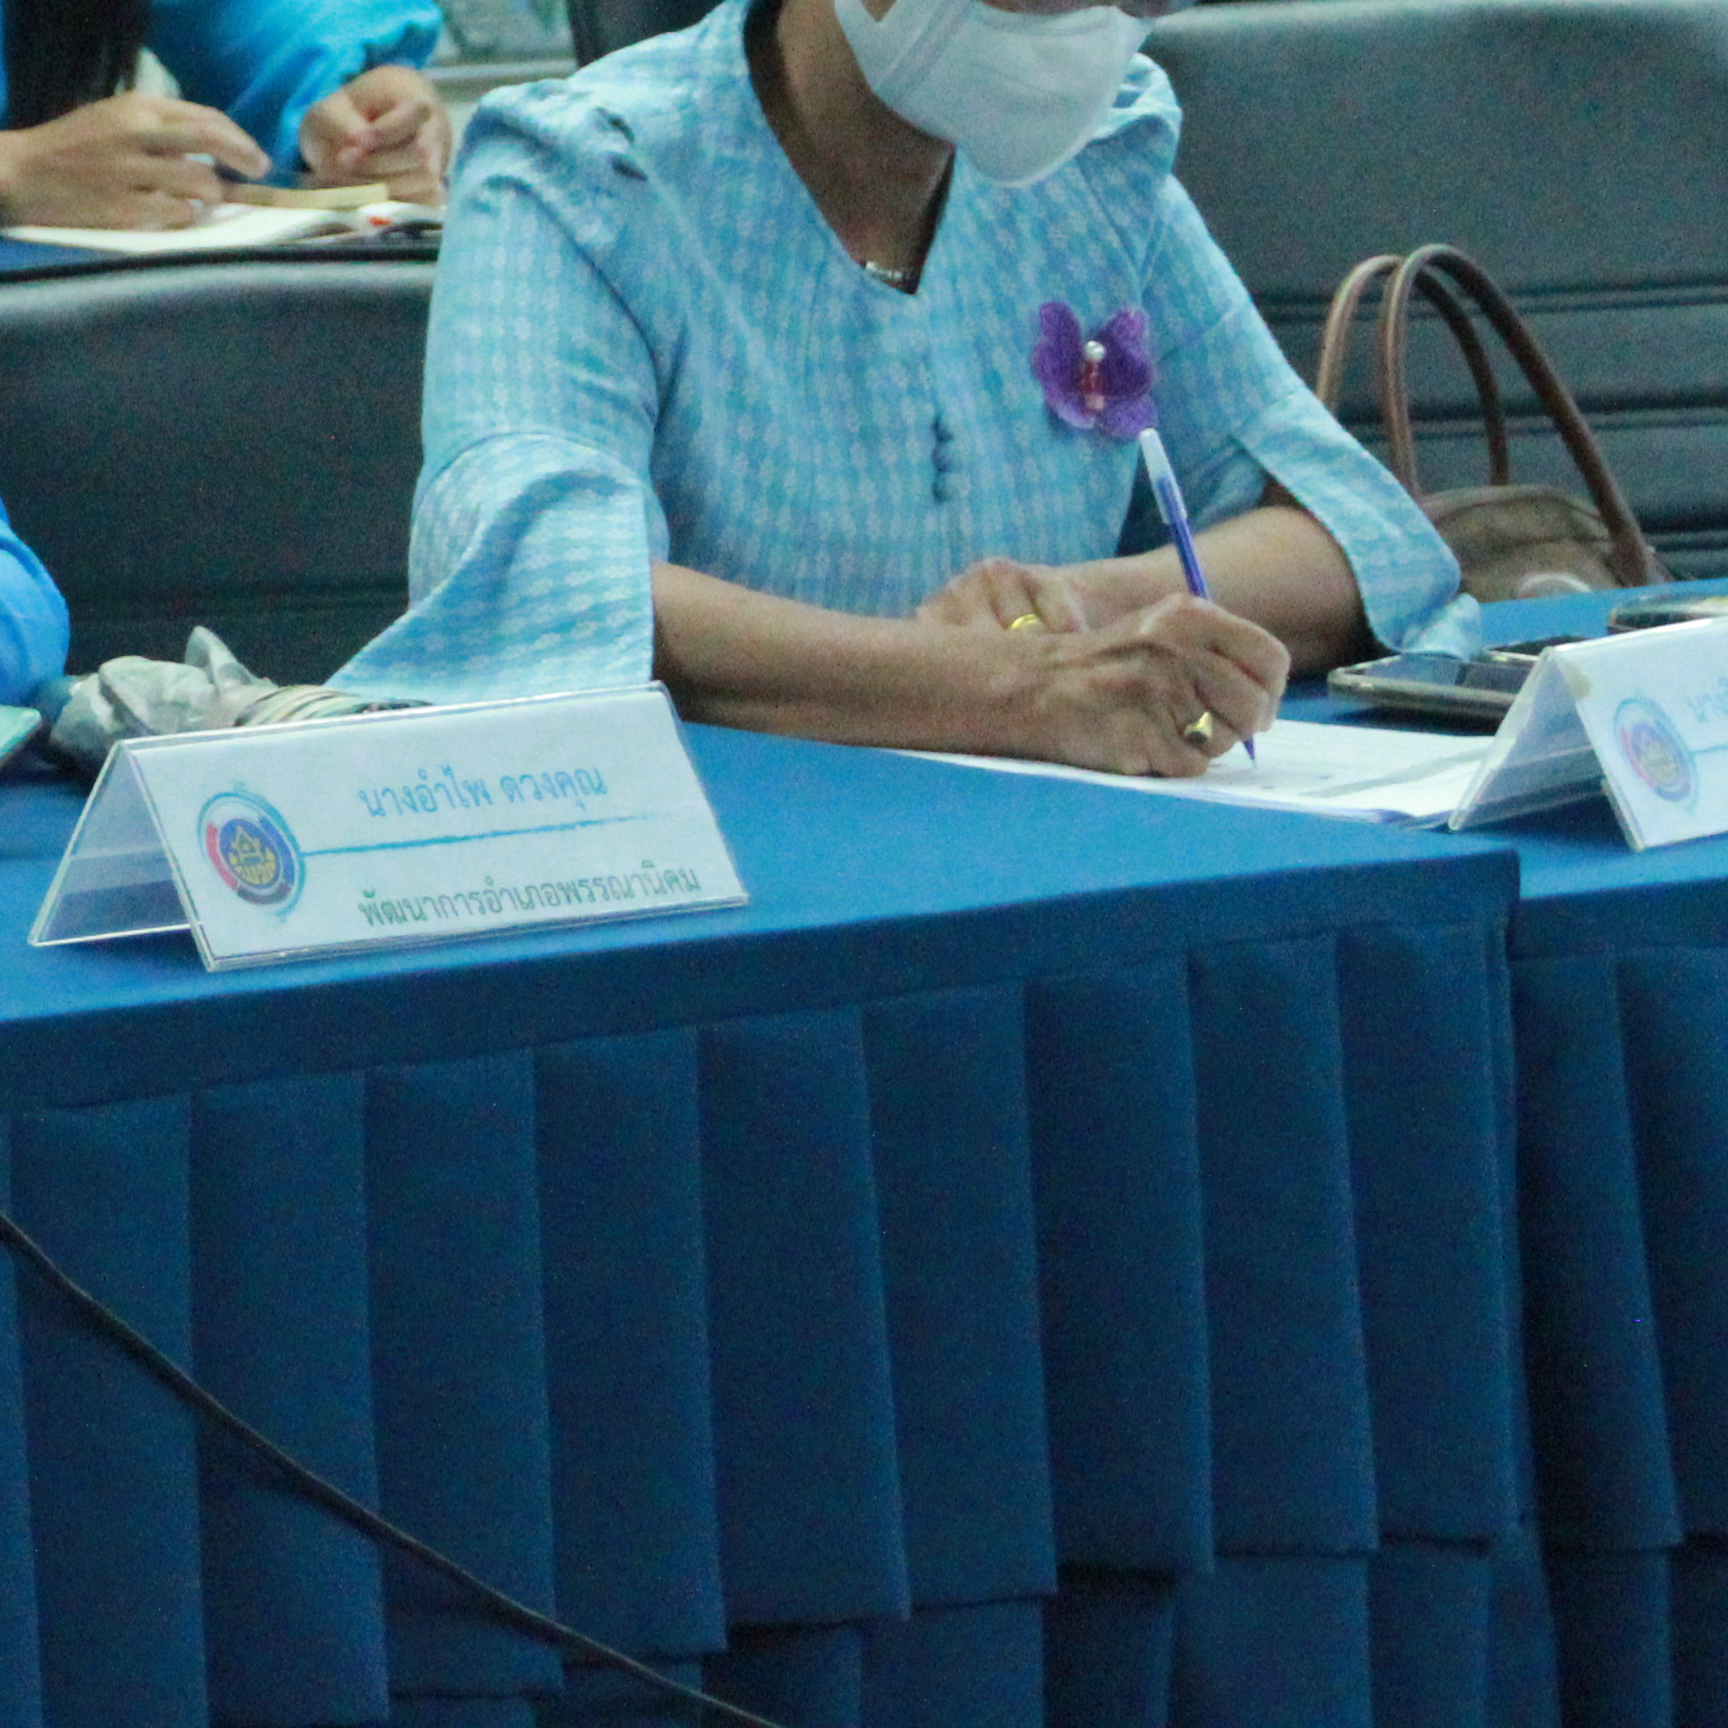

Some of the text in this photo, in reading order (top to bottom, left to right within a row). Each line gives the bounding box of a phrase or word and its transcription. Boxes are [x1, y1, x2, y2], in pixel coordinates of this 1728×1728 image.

[500, 766, 609, 812] ดวงคุณ
[357, 858, 702, 927] พัฒนาการอำเภอพรรณานิคม
